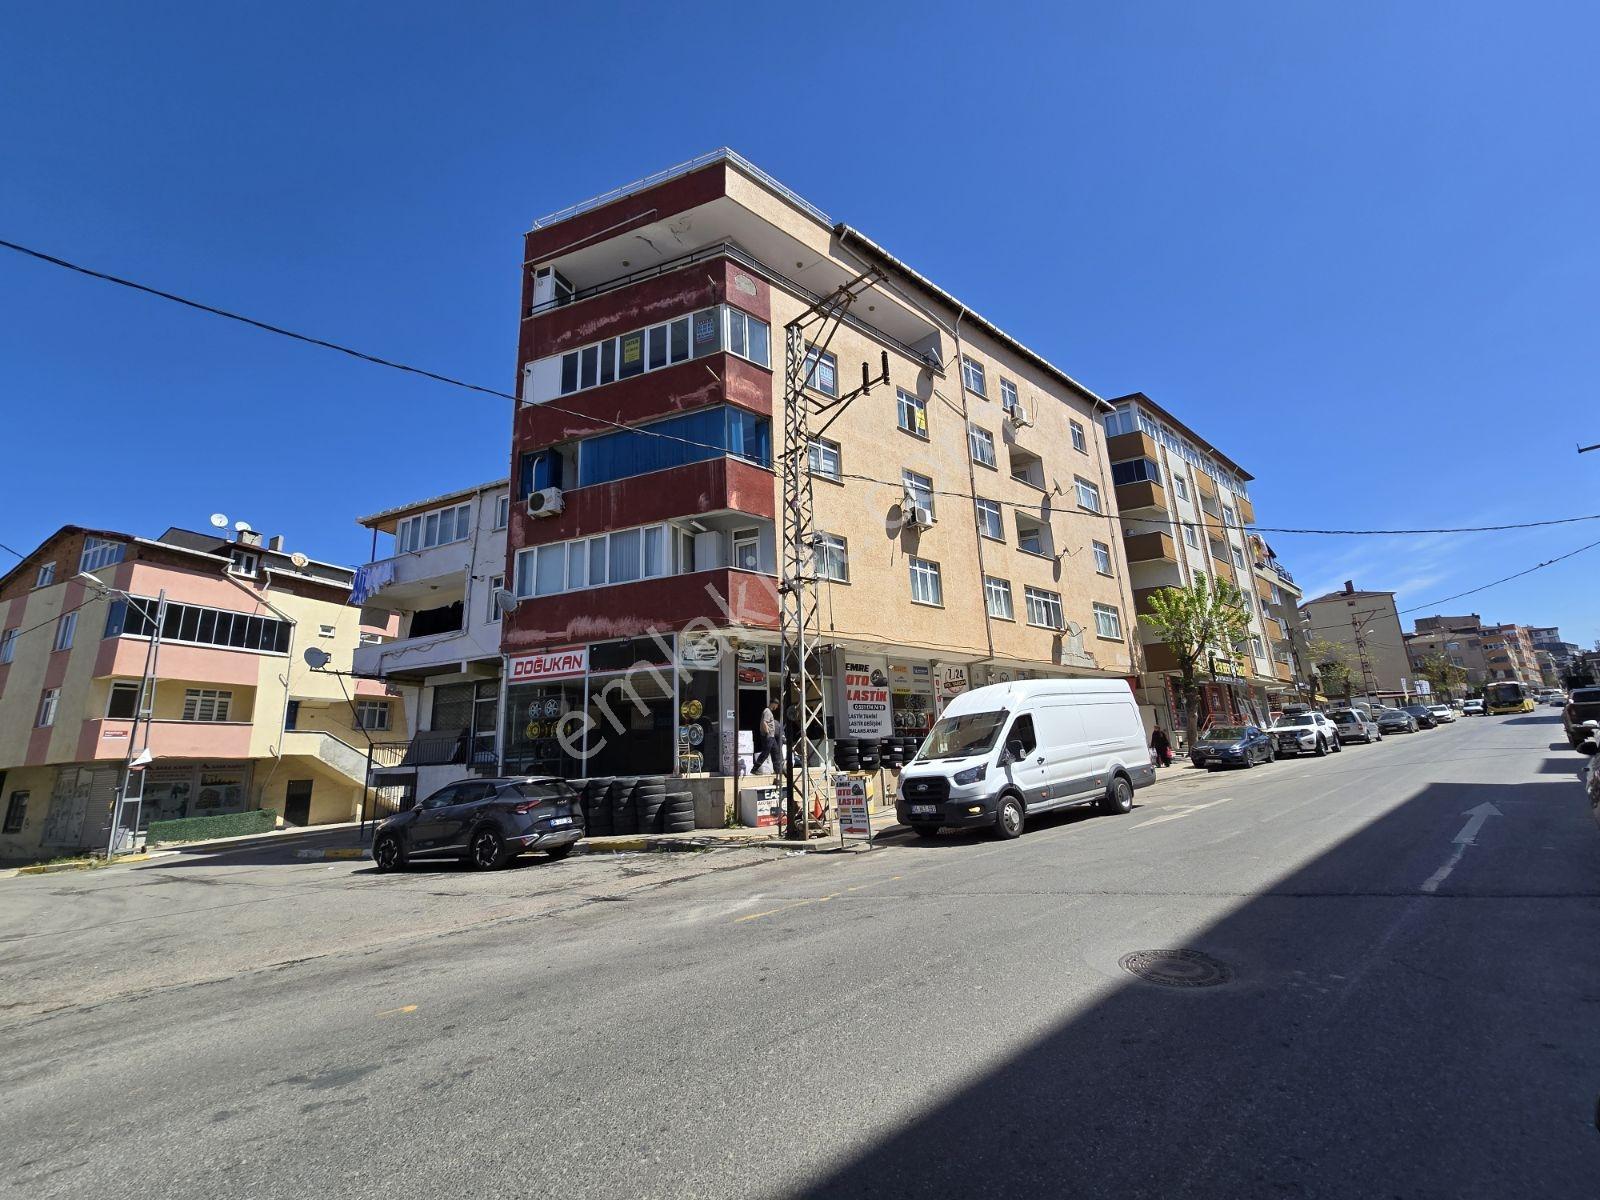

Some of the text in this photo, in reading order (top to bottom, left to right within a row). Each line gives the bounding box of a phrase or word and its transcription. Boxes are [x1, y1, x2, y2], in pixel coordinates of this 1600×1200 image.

[514, 654, 583, 675] DOĞUKAN
[845, 663, 870, 672] EMRE
[846, 674, 870, 686] OTO
[846, 688, 887, 702] LASTİK
[838, 796, 863, 805] LASTİK
